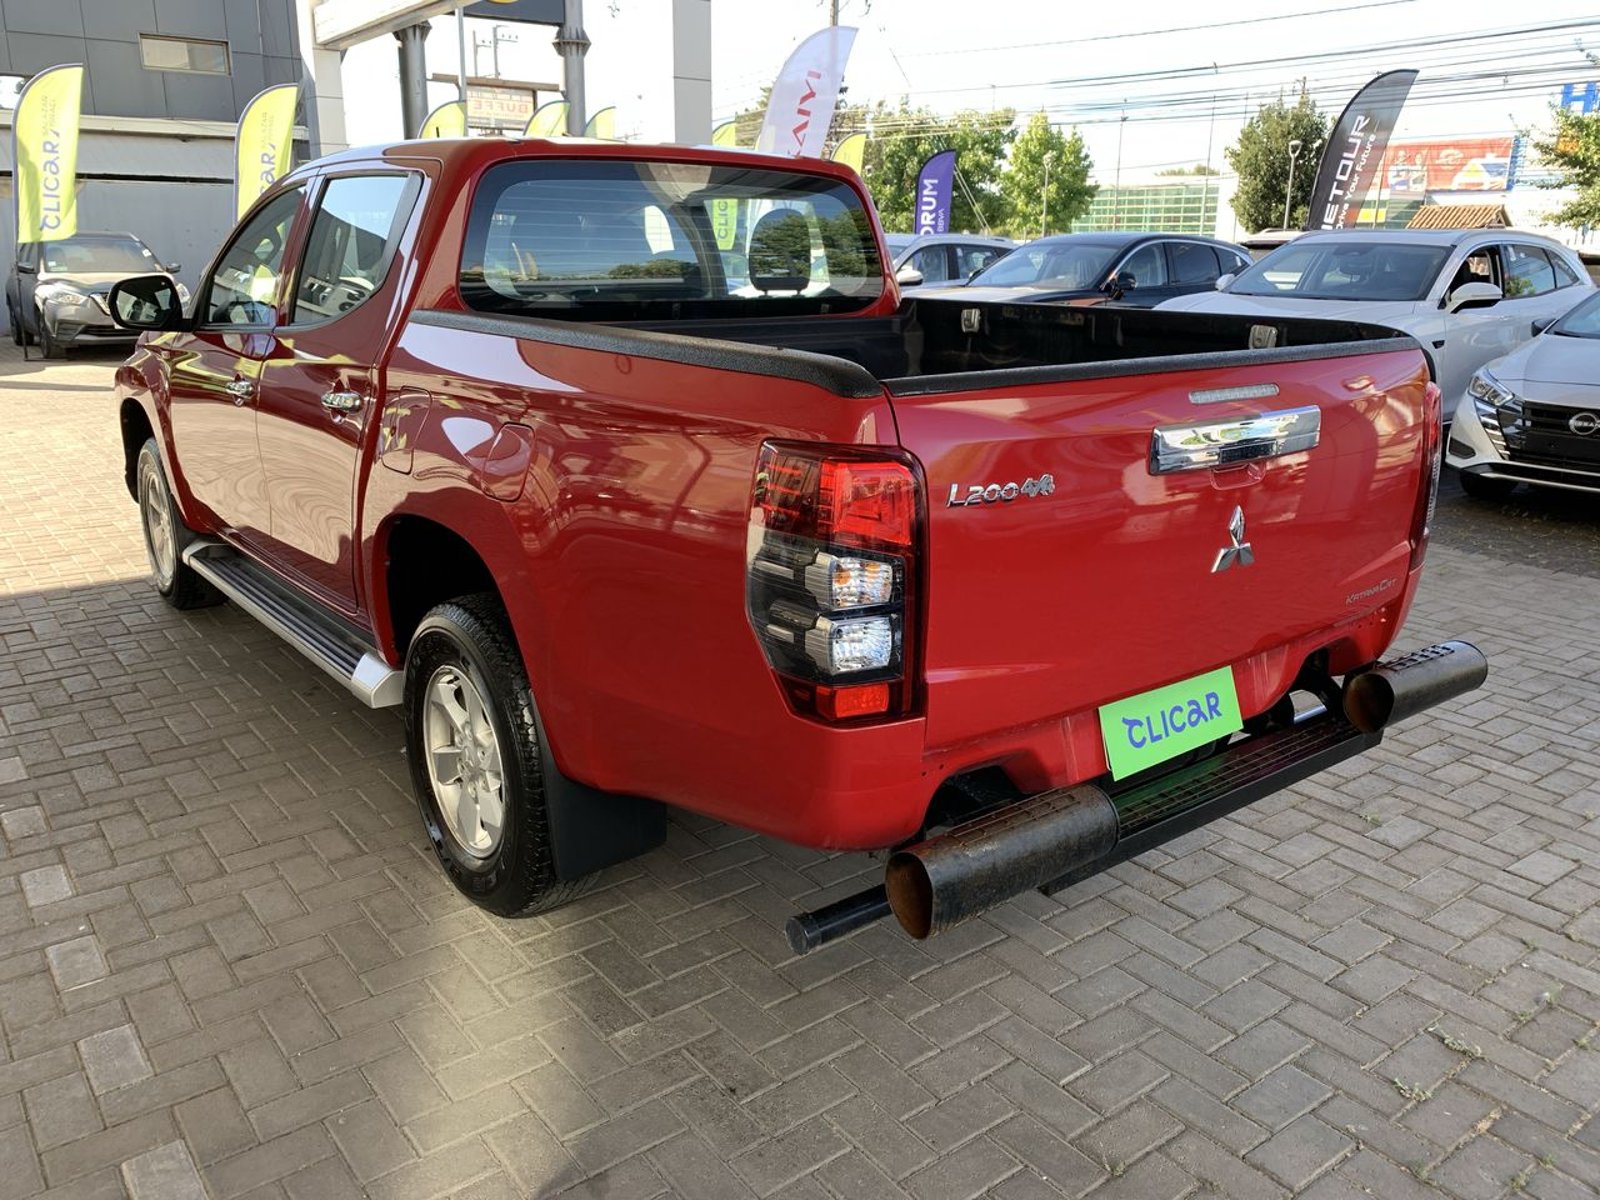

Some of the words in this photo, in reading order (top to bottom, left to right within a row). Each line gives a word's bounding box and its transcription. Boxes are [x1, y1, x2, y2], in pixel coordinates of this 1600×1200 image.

[1344, 173, 1362, 202] Your
[1355, 133, 1377, 172] Future
[946, 481, 1020, 508] L200
